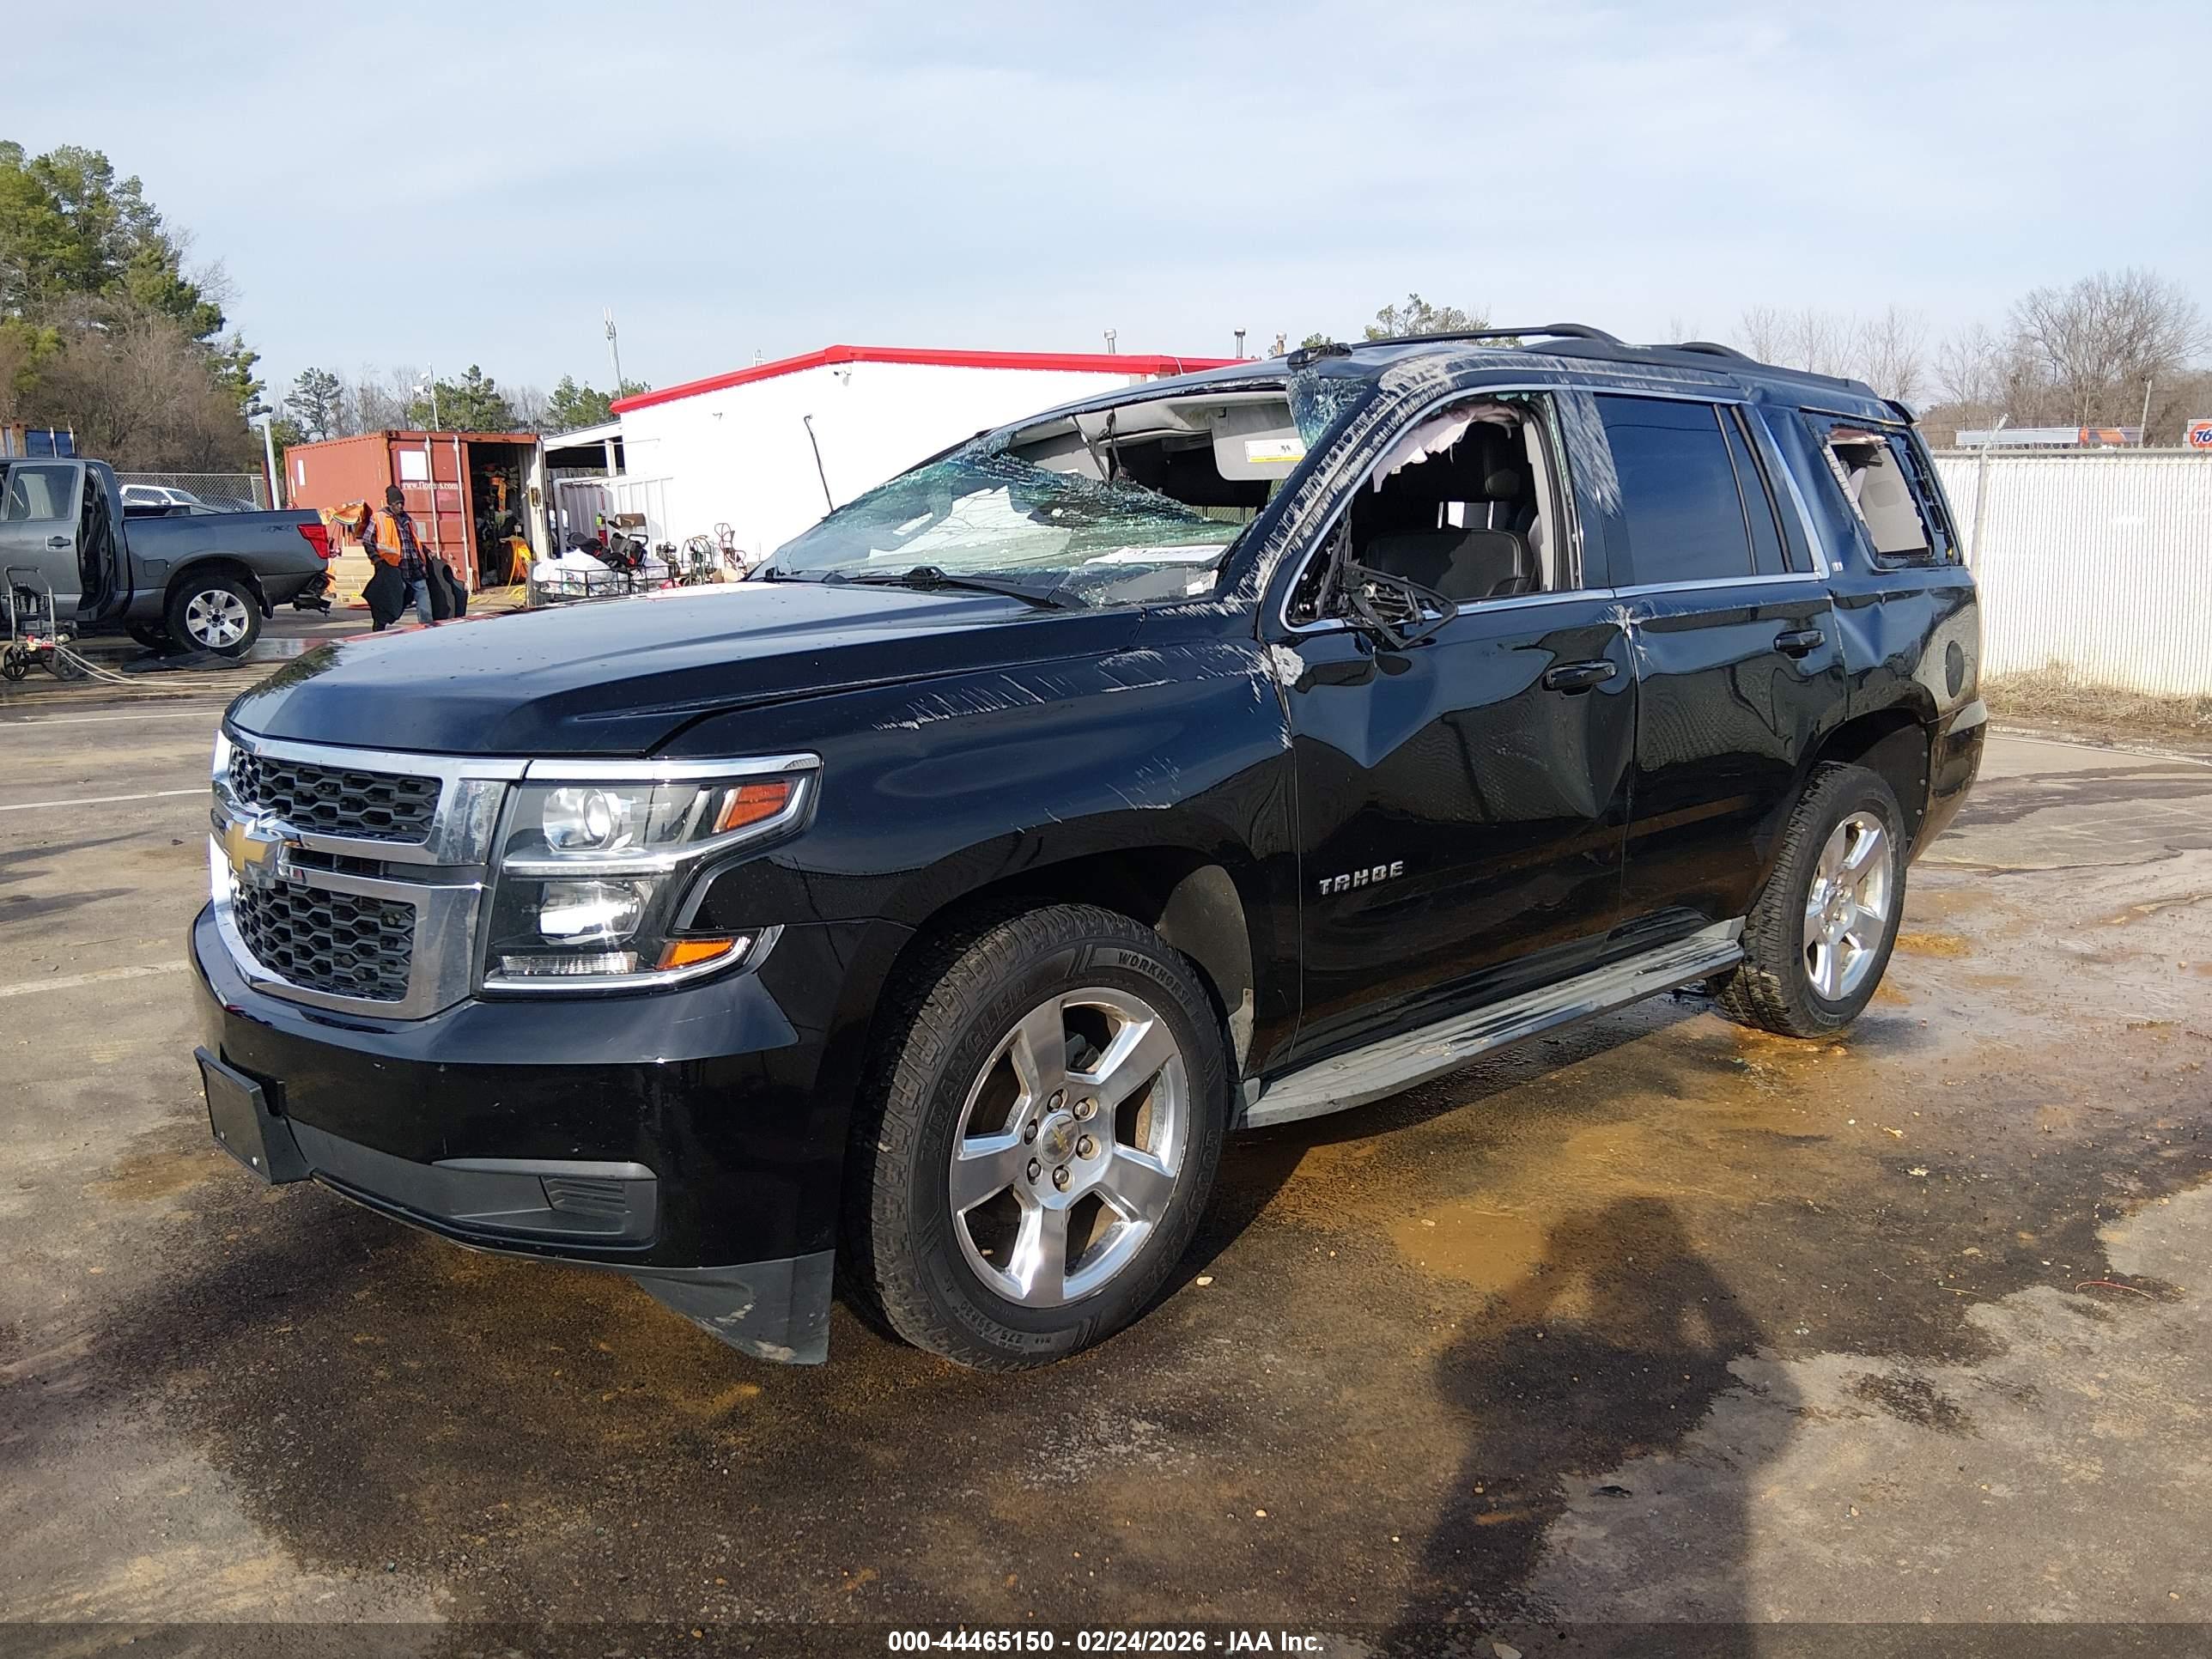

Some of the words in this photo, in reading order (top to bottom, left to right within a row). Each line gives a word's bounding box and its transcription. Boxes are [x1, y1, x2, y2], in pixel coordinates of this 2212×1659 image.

[2195, 429, 2212, 442] 76
[1319, 860, 1403, 895] TAHOE
[1118, 951, 1194, 1005] WORKHORSE
